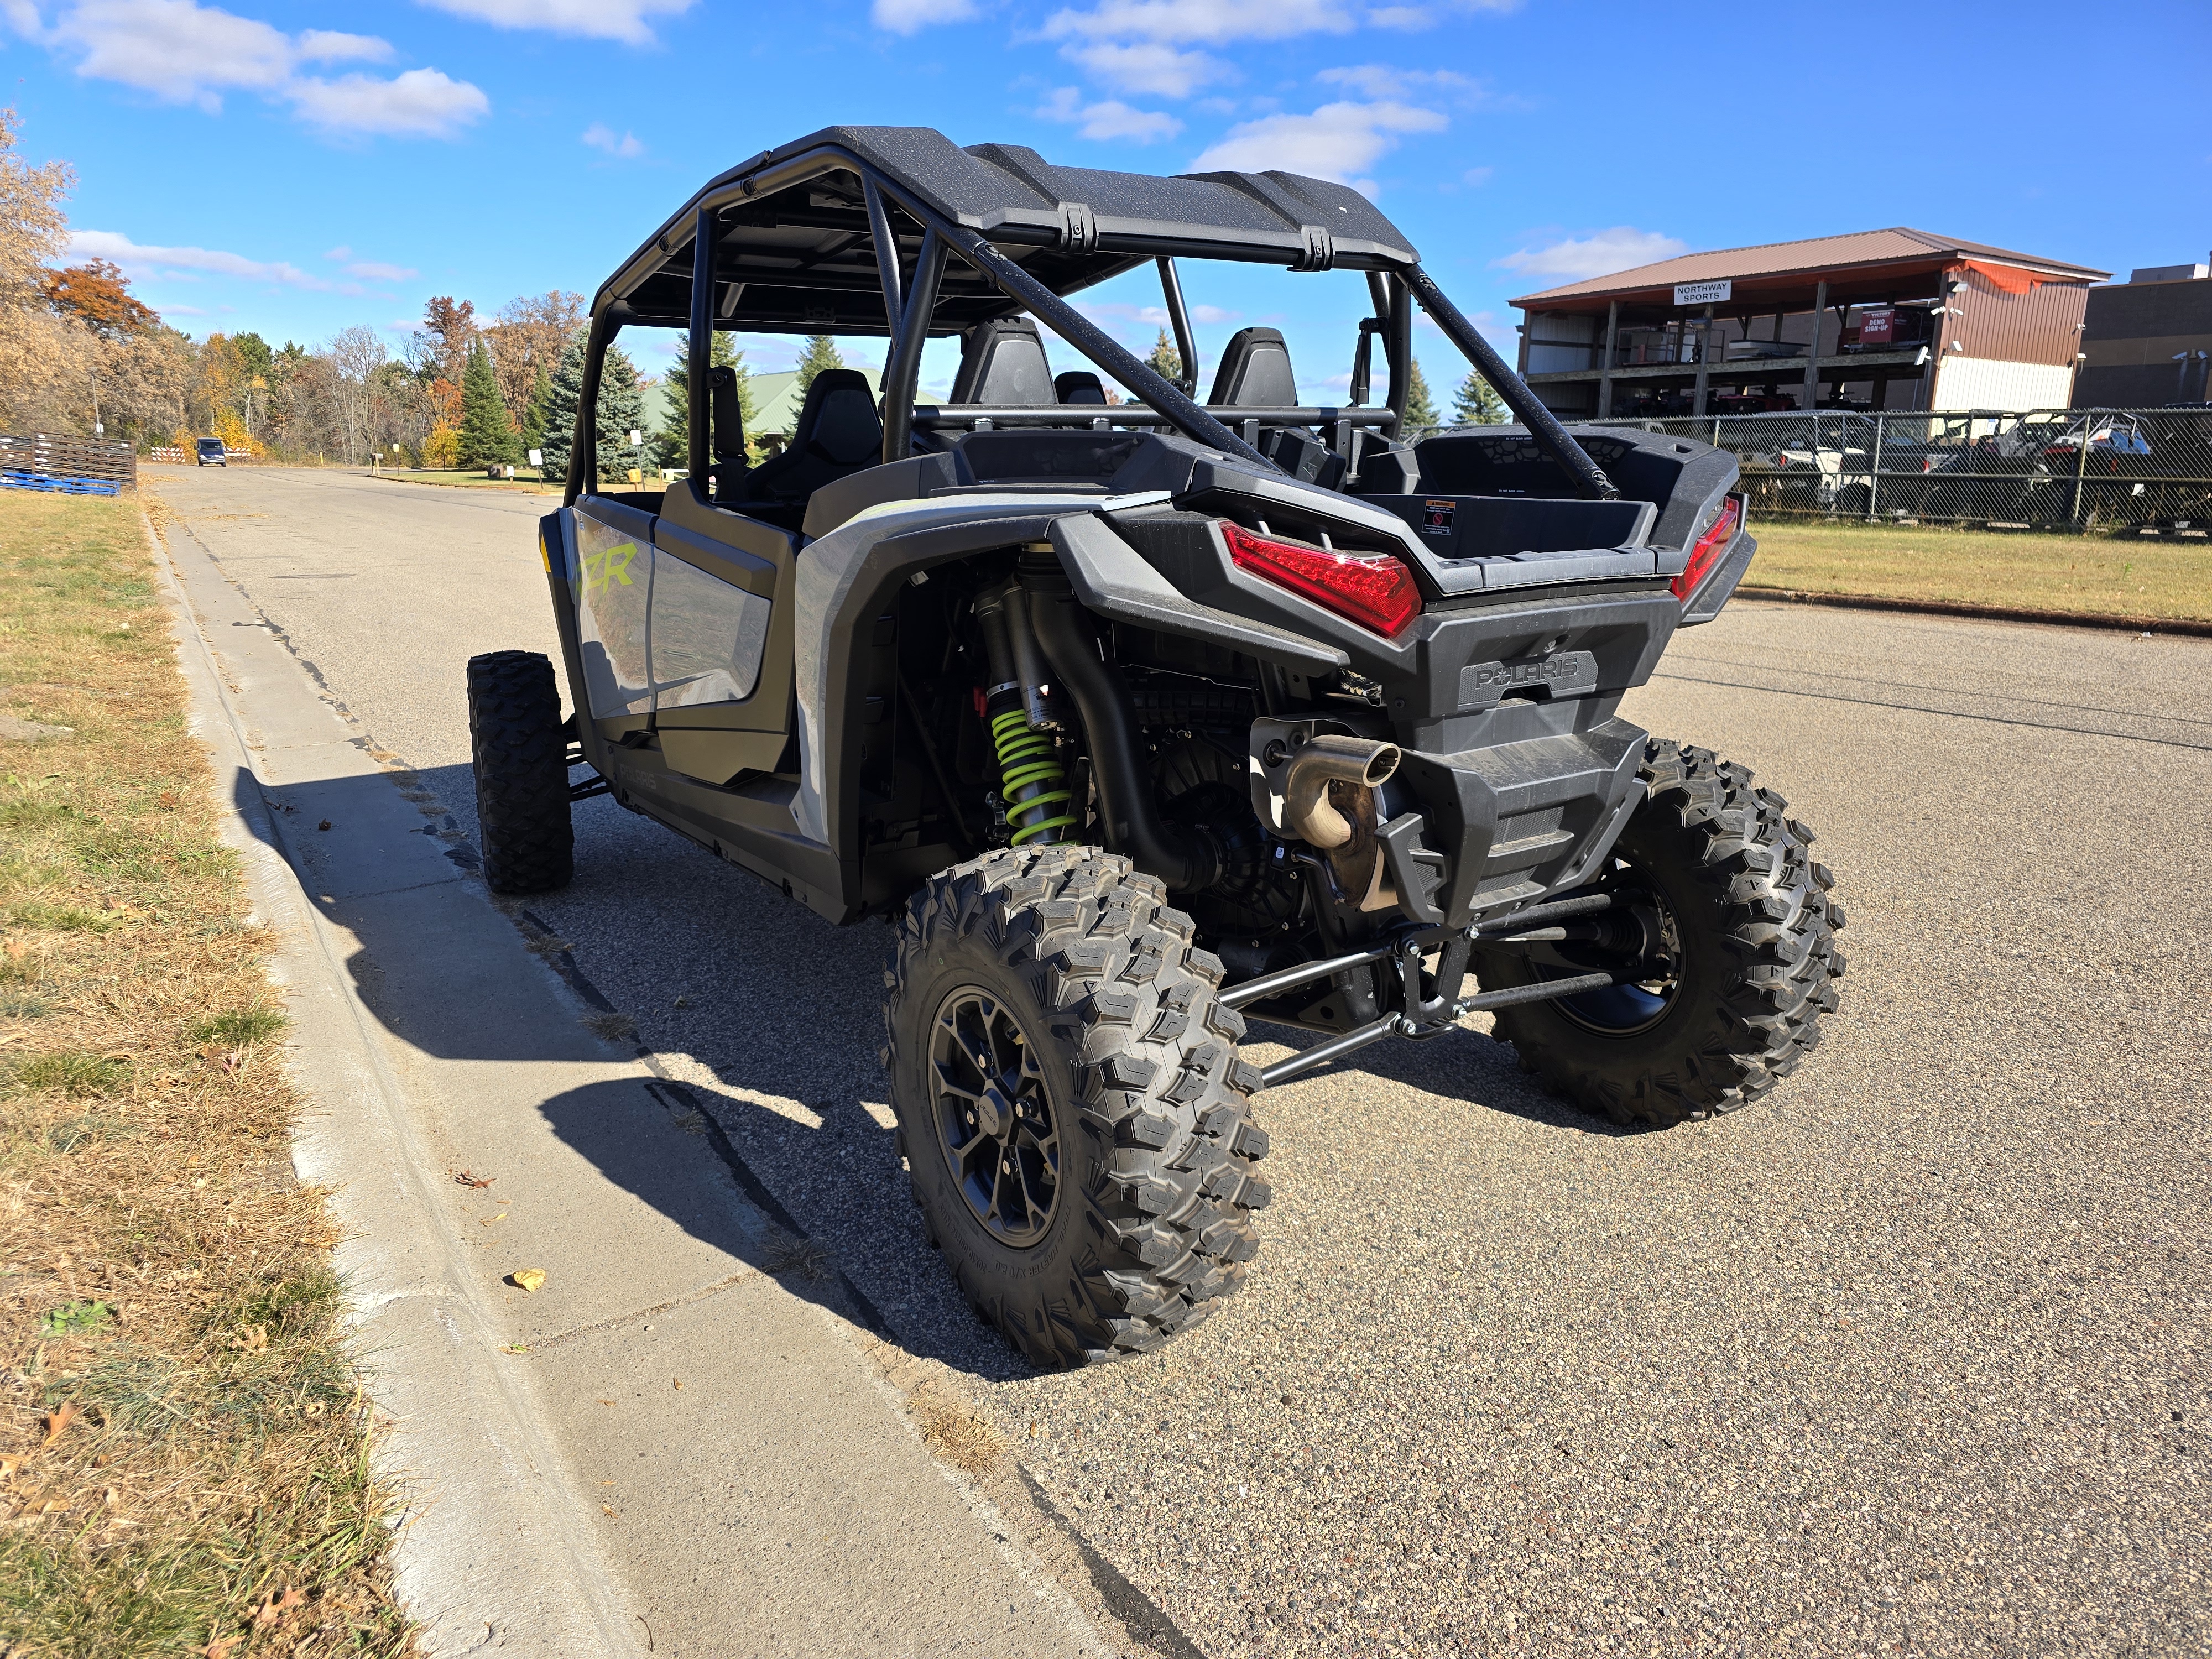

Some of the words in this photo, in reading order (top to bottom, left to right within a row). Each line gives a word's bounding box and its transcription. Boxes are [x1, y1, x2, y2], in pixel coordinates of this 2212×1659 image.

[1678, 283, 1726, 294] NORTHWAY
[1684, 292, 1719, 302] SPORTS
[1865, 324, 1888, 332] SIGN-UP
[1475, 658, 1578, 690] POLARIS
[619, 763, 656, 790] POLARIS
[1057, 1204, 1071, 1244] TRAIL
[1029, 1245, 1058, 1277] MASTER
[1010, 1267, 1026, 1279] X/T
